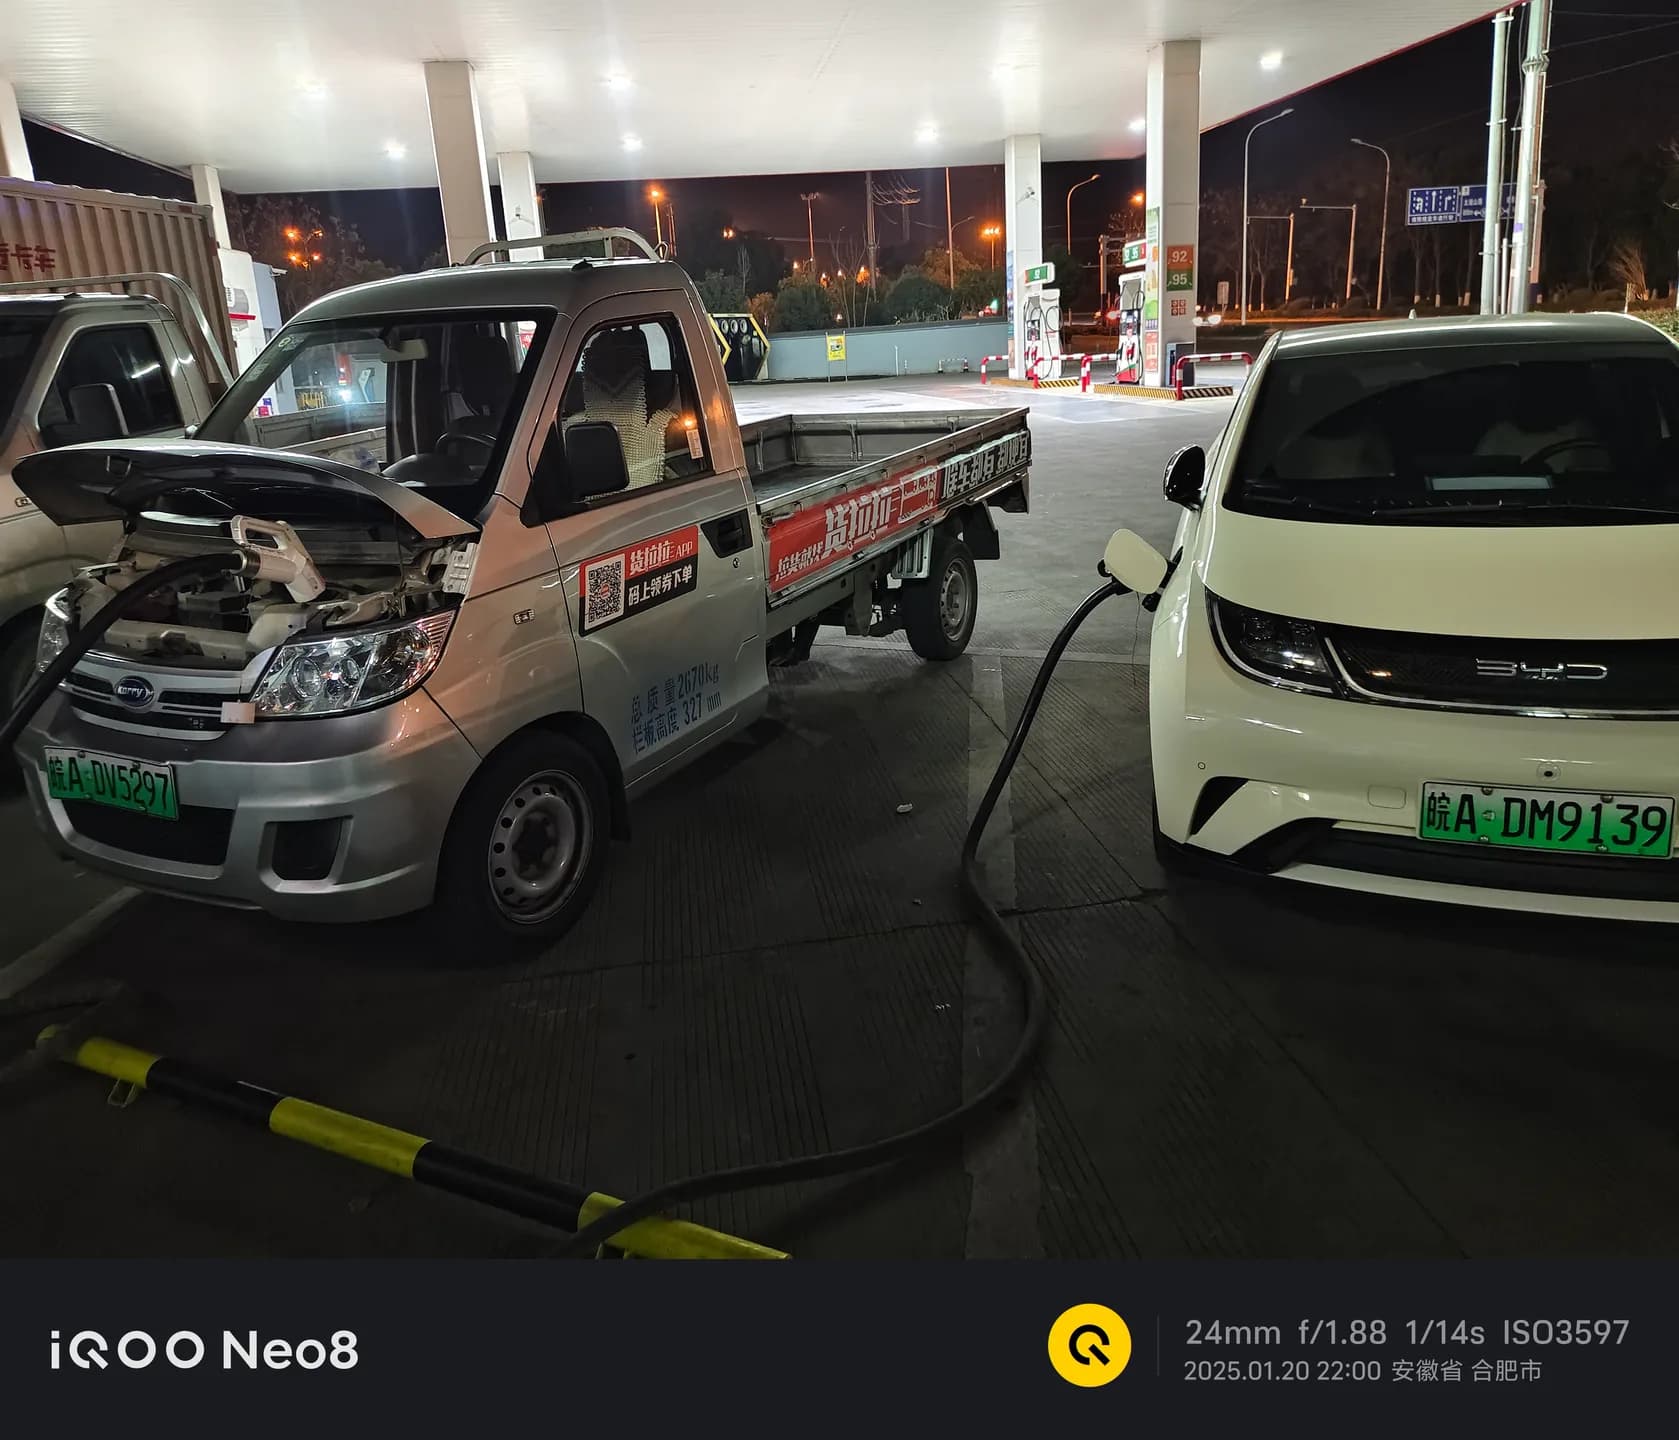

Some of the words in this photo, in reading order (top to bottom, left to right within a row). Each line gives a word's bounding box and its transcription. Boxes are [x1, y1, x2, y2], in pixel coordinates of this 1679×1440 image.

[1172, 250, 1188, 263] 92
[1172, 273, 1188, 286] 95
[629, 540, 673, 576] 货拉拉
[675, 541, 693, 559] APP
[628, 564, 693, 606] 码上领券下单
[1475, 658, 1608, 680] BYD
[683, 692, 702, 726] 327
